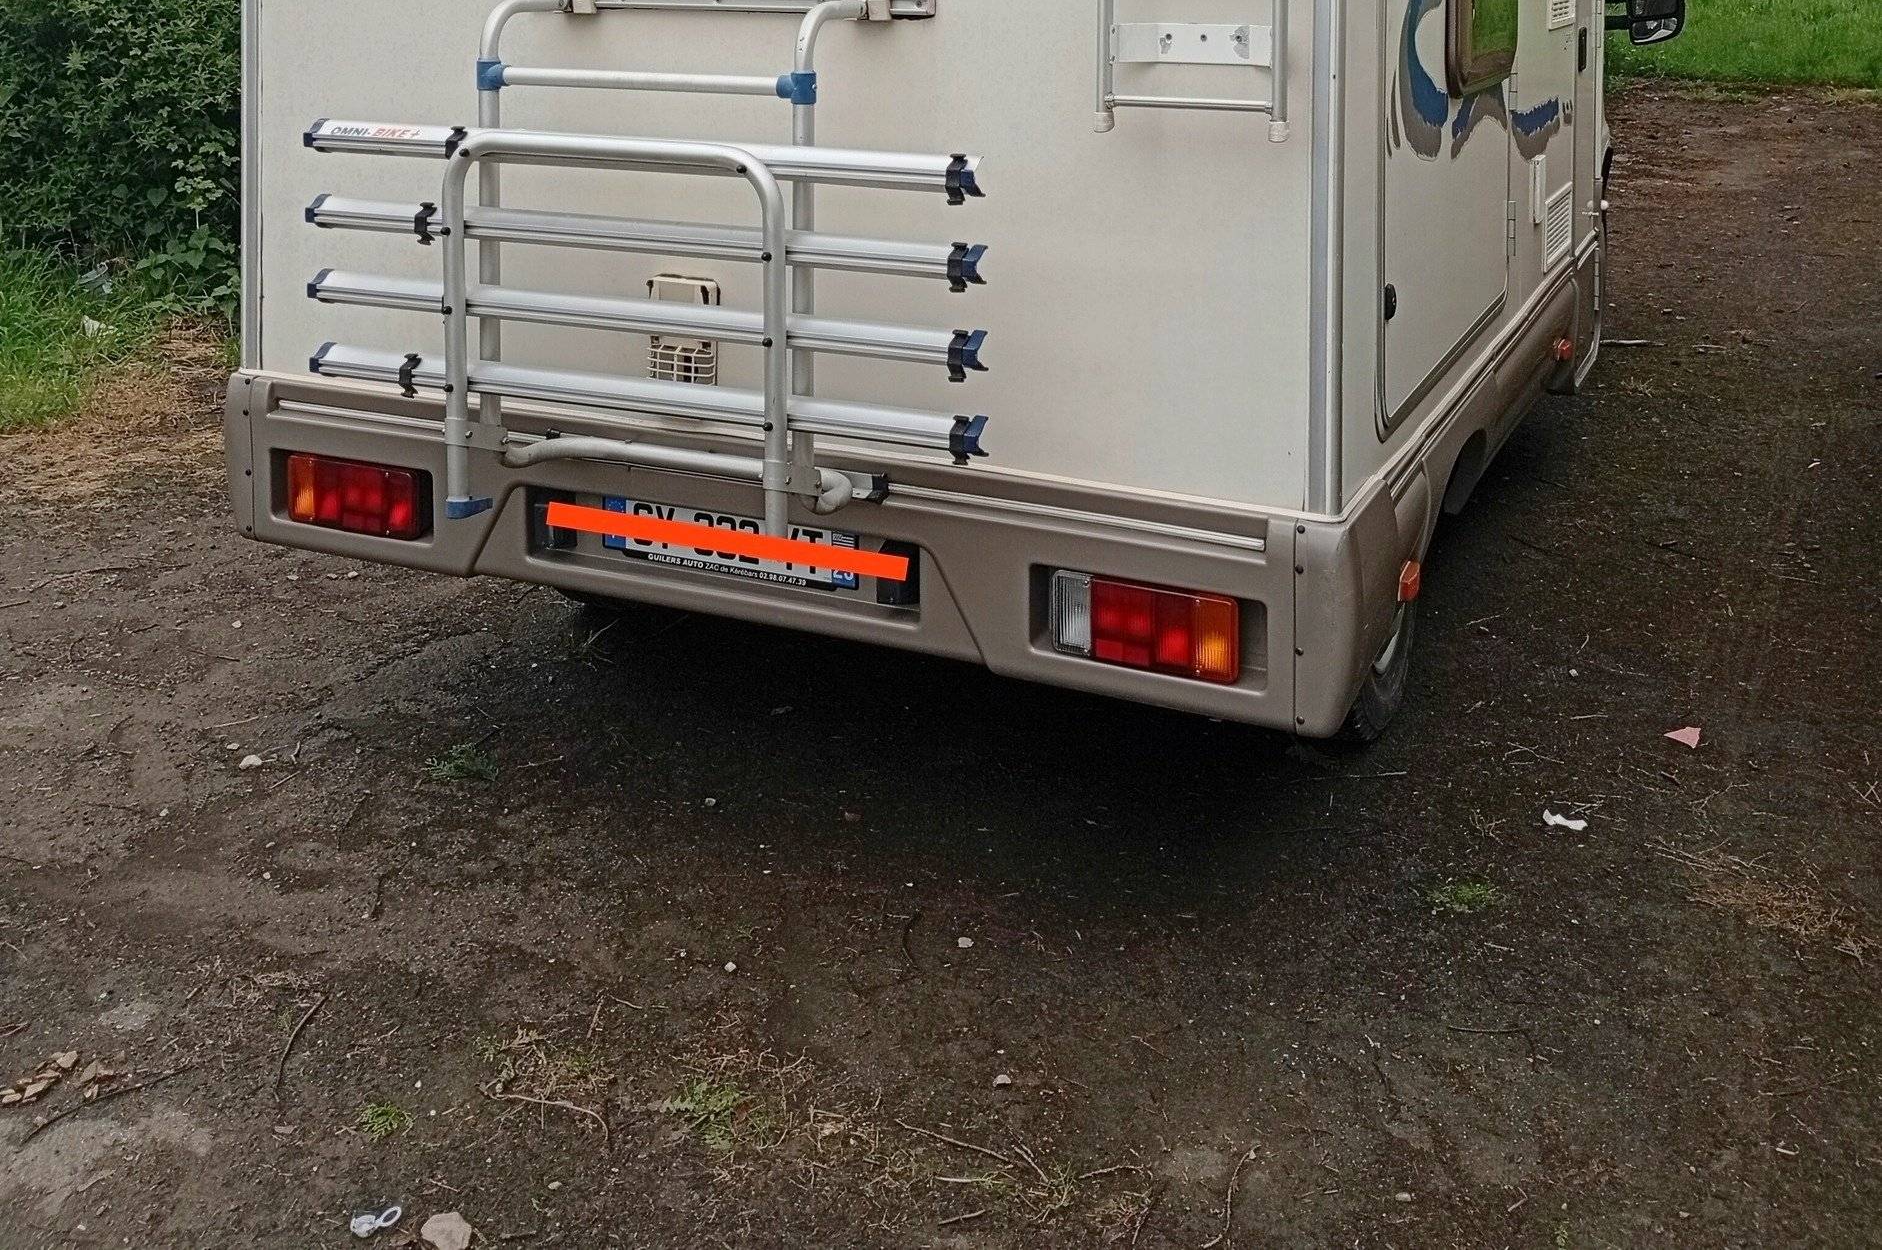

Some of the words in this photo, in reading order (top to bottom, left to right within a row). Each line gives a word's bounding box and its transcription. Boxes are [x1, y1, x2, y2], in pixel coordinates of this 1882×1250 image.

[647, 553, 681, 565] GUILERS
[682, 559, 704, 569] AUTO
[705, 562, 719, 571] ZAC
